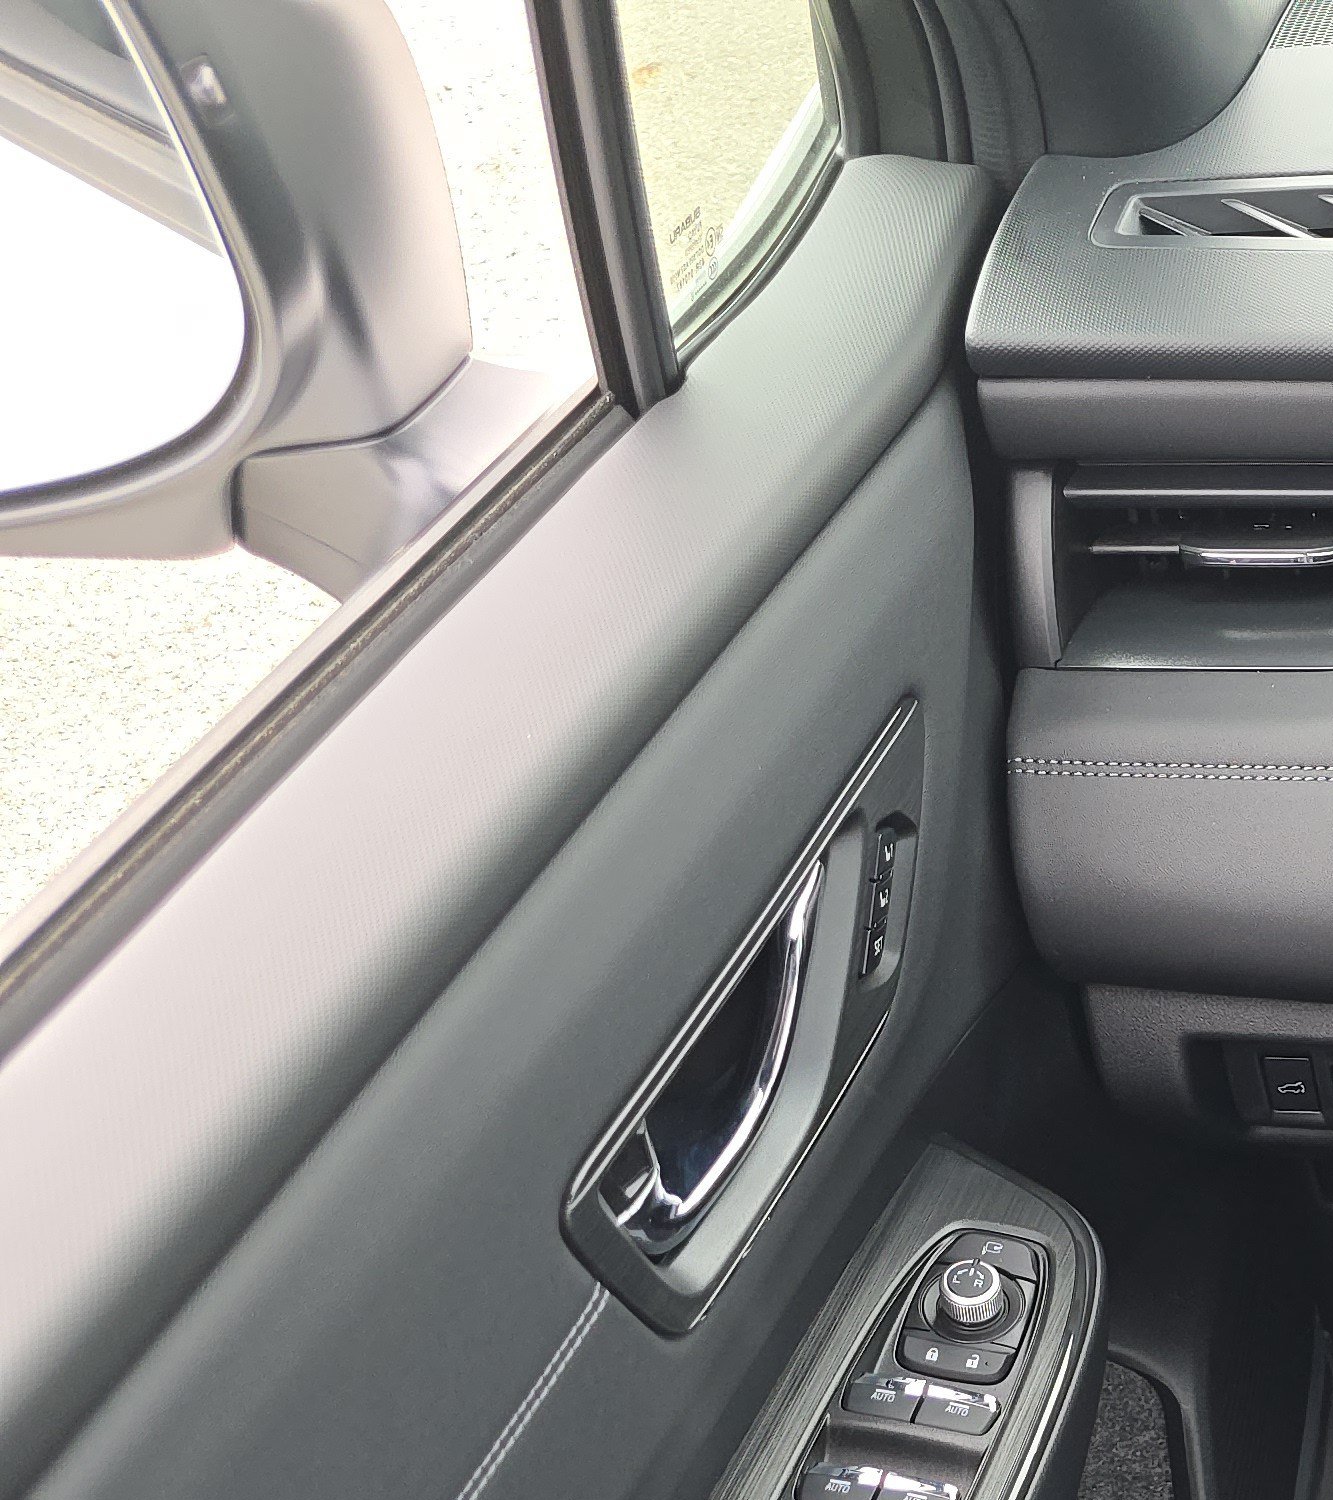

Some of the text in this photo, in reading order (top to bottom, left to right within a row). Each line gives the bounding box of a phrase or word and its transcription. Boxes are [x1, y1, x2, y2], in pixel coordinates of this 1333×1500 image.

[973, 1279, 984, 1288] R
[871, 1392, 895, 1403] AUTO
[945, 1404, 969, 1417] AUTO
[825, 1483, 851, 1494] AUTO
